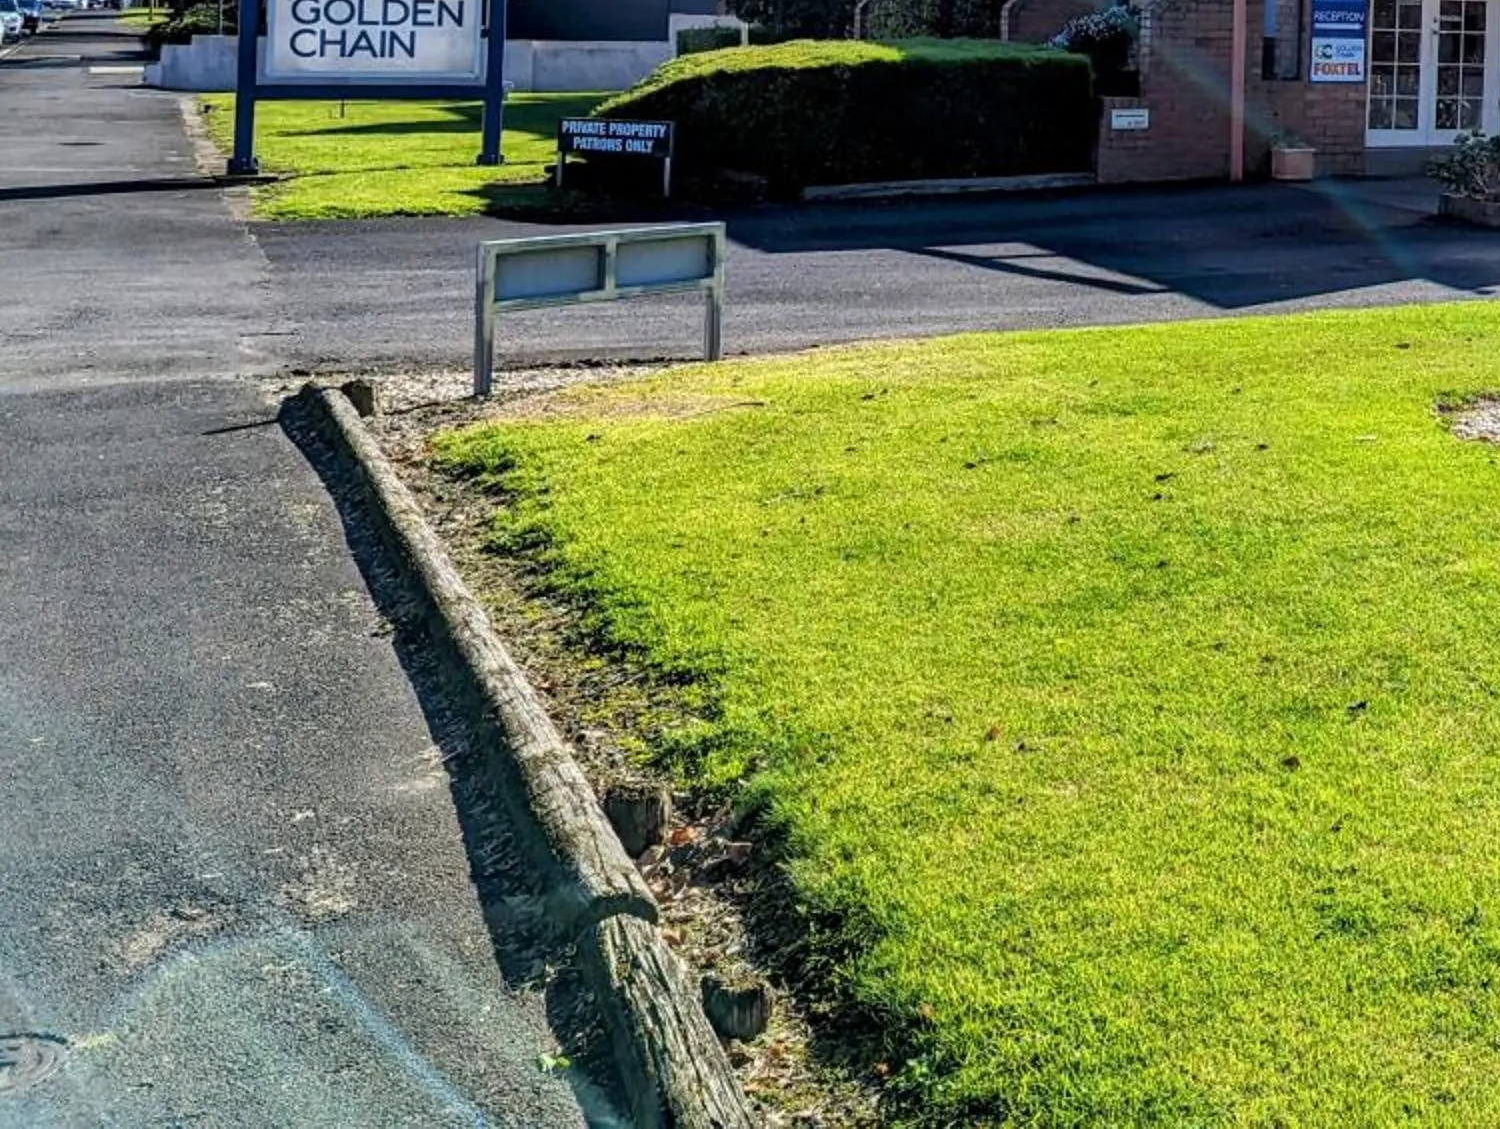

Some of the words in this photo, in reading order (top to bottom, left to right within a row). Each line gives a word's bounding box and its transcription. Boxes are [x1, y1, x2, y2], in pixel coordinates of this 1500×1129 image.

[1314, 11, 1365, 22] RECEPTION
[289, 29, 417, 59] CHAIN
[1313, 62, 1361, 76] FOXTEL
[562, 121, 607, 135] PRIVATE
[609, 123, 667, 138] PROPERTY
[573, 136, 623, 151] PATRONS
[625, 138, 655, 153] ONLY
